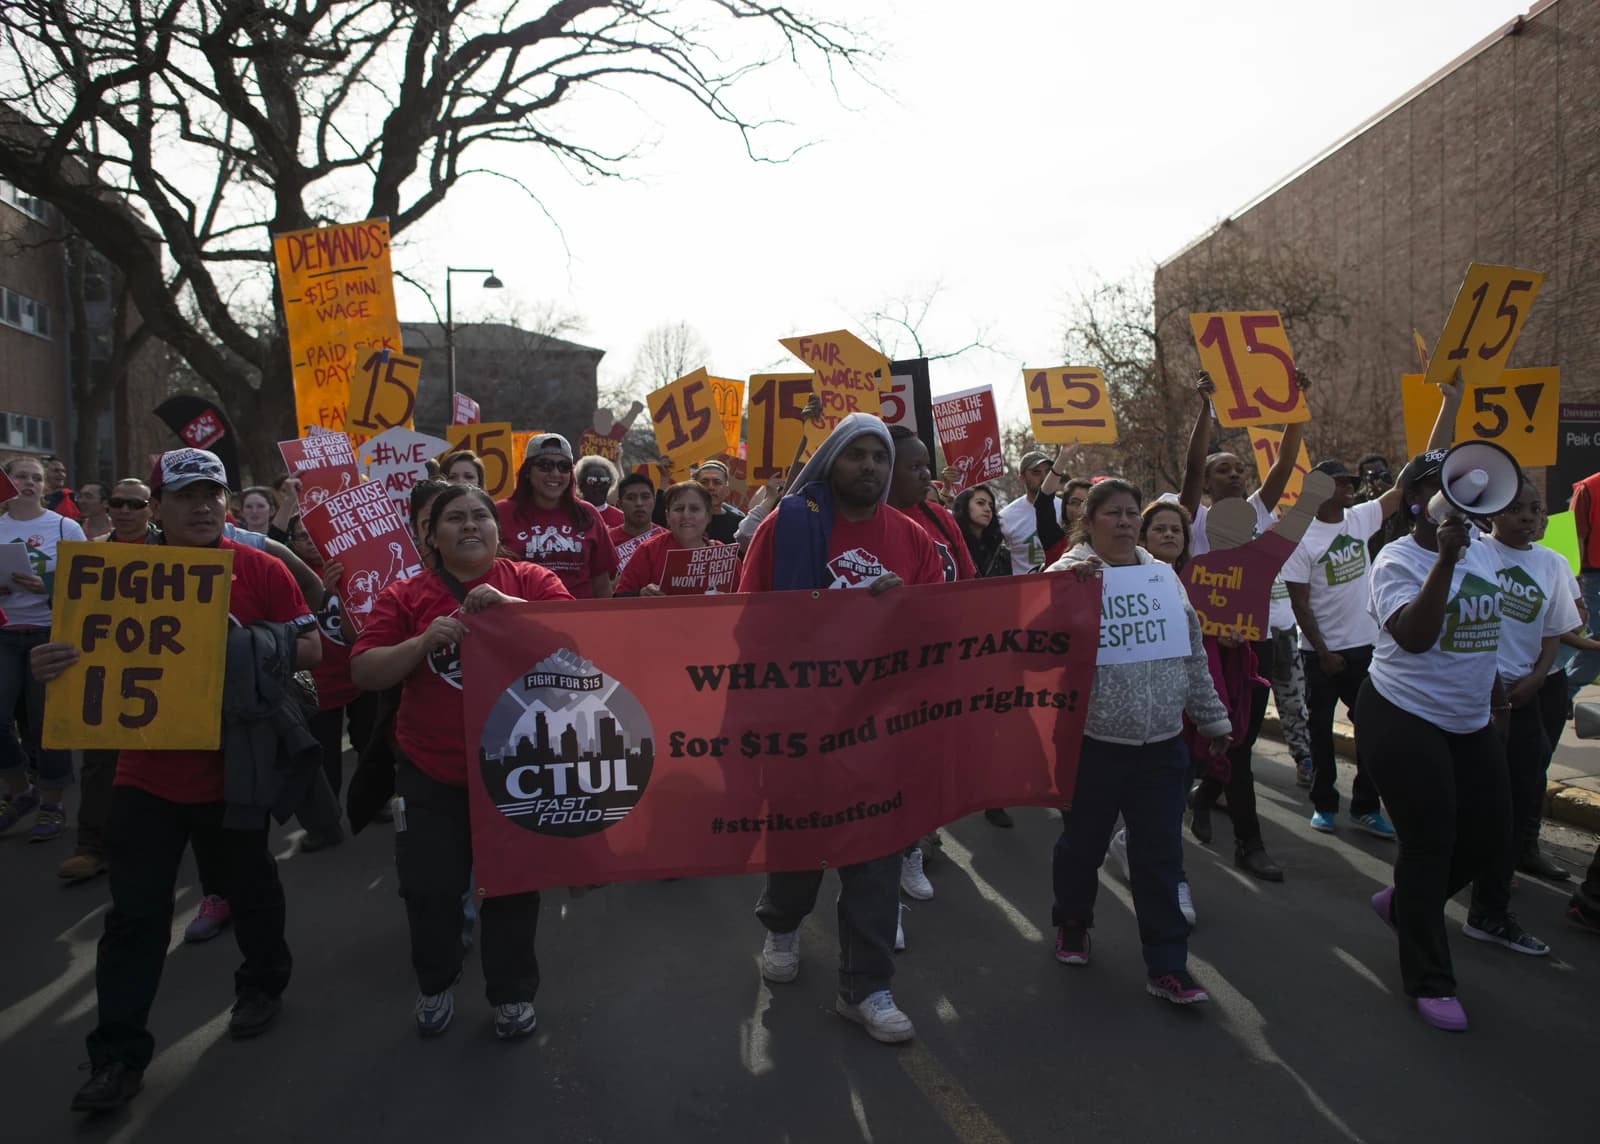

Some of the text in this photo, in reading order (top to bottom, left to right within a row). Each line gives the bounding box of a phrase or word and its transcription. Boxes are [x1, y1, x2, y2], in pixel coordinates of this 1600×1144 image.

[287, 224, 388, 273] DEMANDS:
[305, 278, 381, 306] $15 MIN.
[316, 301, 370, 323] WAGE
[1448, 280, 1533, 360] 15
[799, 338, 845, 367] FAIR
[314, 361, 355, 389] DAY
[818, 368, 875, 392] WAGES
[1200, 315, 1300, 420] 15
[352, 350, 419, 429] 15
[820, 390, 861, 413] FOR
[1030, 371, 1100, 414] 15
[653, 380, 711, 451] 15
[934, 394, 984, 418] RAISE THE
[936, 408, 982, 431] MINIMUM
[302, 434, 347, 449] BECAUSE
[940, 425, 969, 445] WAGE
[294, 452, 354, 471] WON'T WAIT
[302, 443, 352, 458] THE RENT
[372, 442, 428, 466] #WE
[982, 452, 1002, 470] 15
[983, 466, 1002, 478] NOW
[324, 481, 387, 518] BECAUSE
[328, 497, 395, 535] THE RENT
[324, 526, 368, 559] WON'T
[365, 514, 401, 539] WAIT
[687, 558, 736, 576] THE RENT
[691, 545, 737, 564] BECAUSE
[68, 554, 225, 605] FIGHT
[671, 571, 733, 588] WON'T WAIT
[1190, 564, 1243, 591] Morrill
[1152, 597, 1162, 612] &
[1207, 588, 1228, 608] to
[81, 614, 186, 656] FOR
[685, 629, 1072, 693] WHATEVER IT TAKES
[526, 674, 602, 690] FIGHT FOR $15
[82, 665, 164, 730] 15
[669, 684, 1079, 759] for $15 and union rights!
[505, 758, 640, 800] CTUL
[534, 796, 592, 814] FAST
[711, 789, 905, 835] #strikefastfood
[537, 809, 603, 827] FOOD
